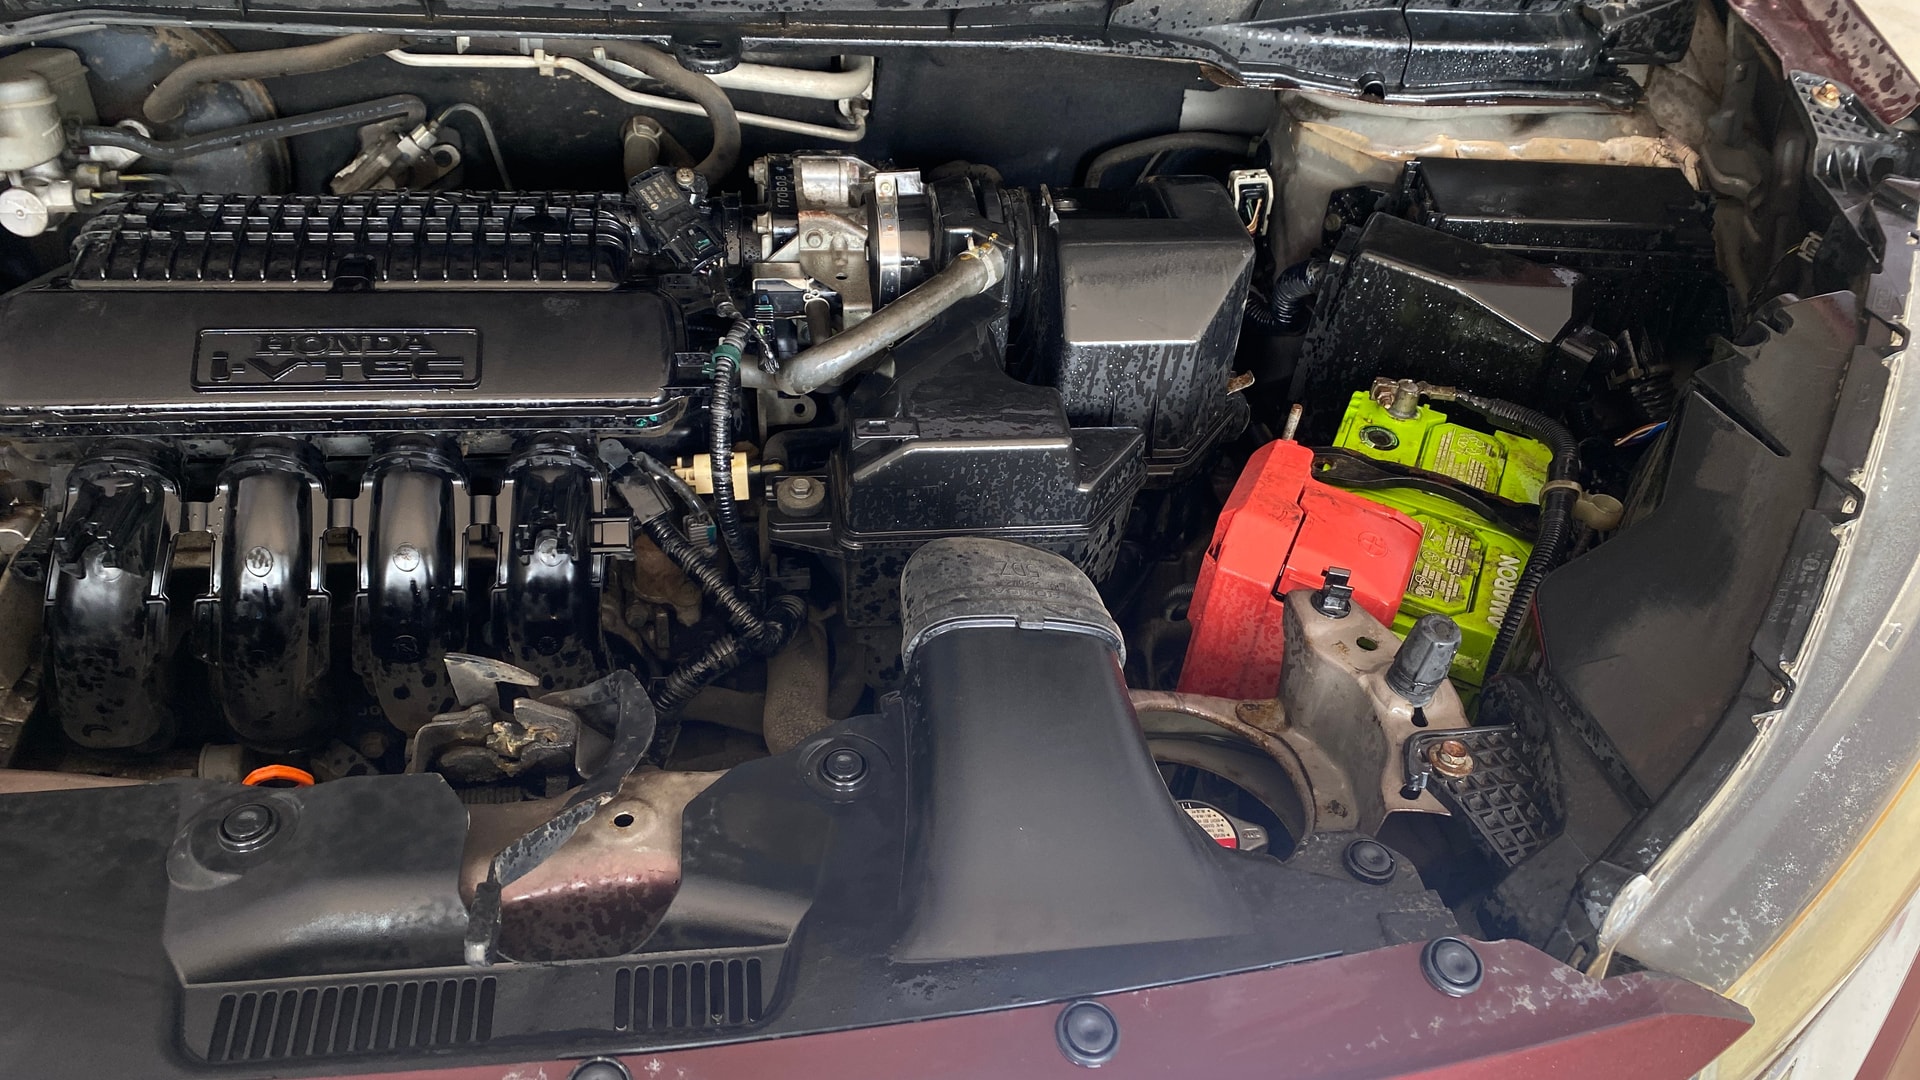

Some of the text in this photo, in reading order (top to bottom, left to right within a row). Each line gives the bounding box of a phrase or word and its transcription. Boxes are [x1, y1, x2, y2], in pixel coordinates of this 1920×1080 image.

[775, 175, 790, 208] 170608
[255, 335, 438, 356] HONDA
[210, 350, 465, 382] i-VTEC
[1487, 554, 1520, 629] AMARON
